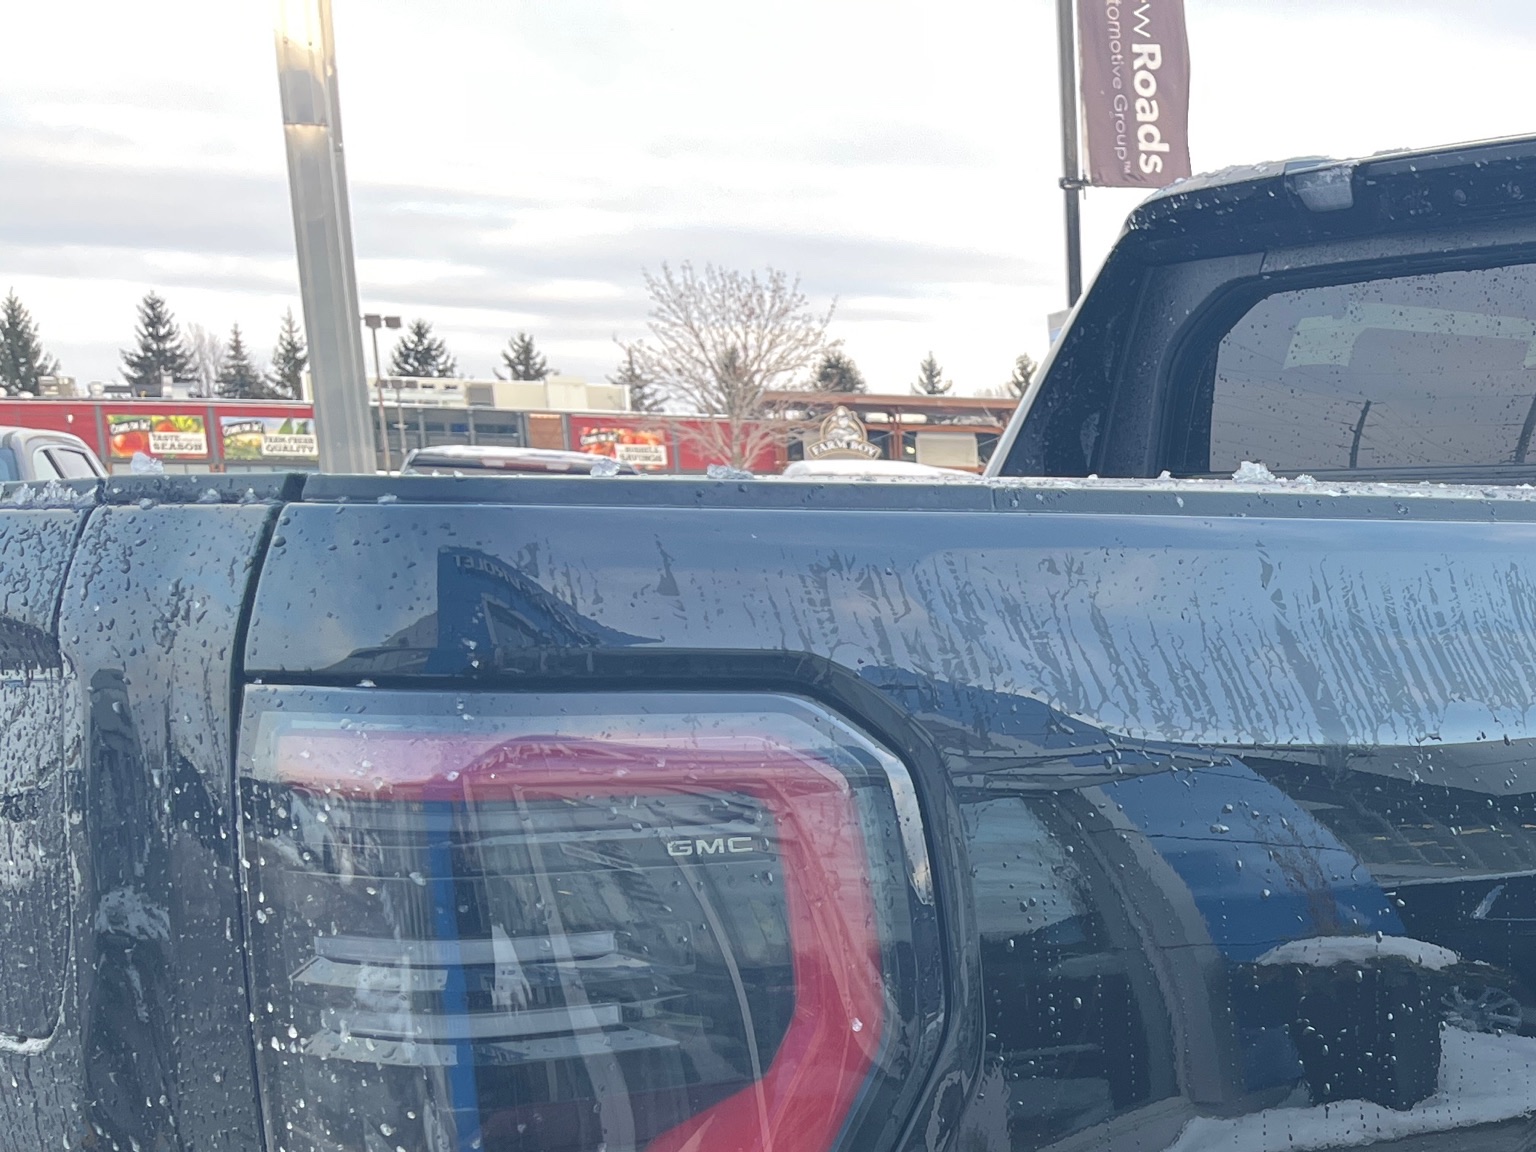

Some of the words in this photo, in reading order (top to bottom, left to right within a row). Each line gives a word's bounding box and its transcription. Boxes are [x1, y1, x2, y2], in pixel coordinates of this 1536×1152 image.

[1106, 0, 1125, 90] tomotive
[1131, 0, 1171, 174] wRoads
[153, 442, 203, 451] SEASON
[265, 444, 315, 453] QUALITY
[811, 438, 847, 456] FARM
[850, 441, 877, 456] BOY
[667, 836, 753, 857] GMC
